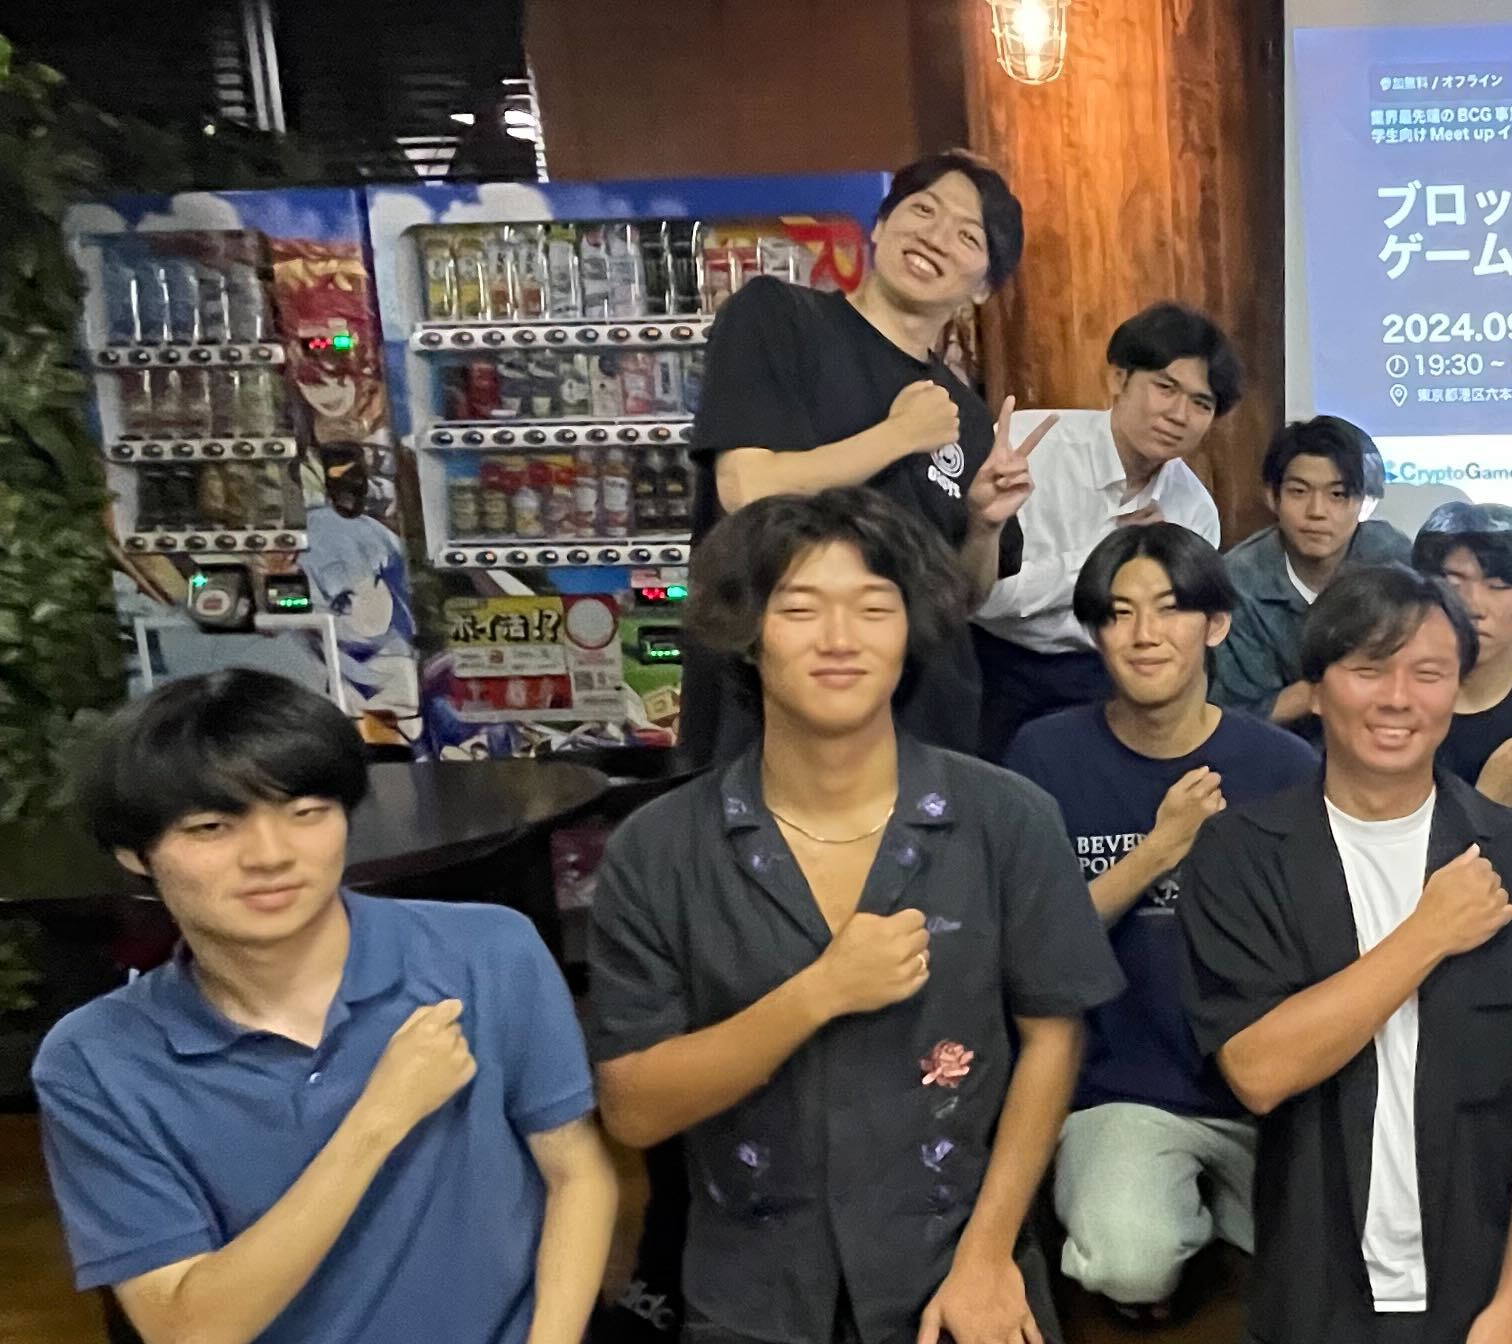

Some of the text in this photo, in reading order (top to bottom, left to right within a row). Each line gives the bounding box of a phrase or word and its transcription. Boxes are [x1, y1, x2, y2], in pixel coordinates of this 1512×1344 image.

[1441, 73, 1504, 89] オフライン
[1457, 106, 1493, 123] BCG
[1370, 126, 1428, 144] 学生向け
[1429, 126, 1470, 143] Meet
[1473, 127, 1496, 144] up
[1415, 353, 1484, 377] 19:30
